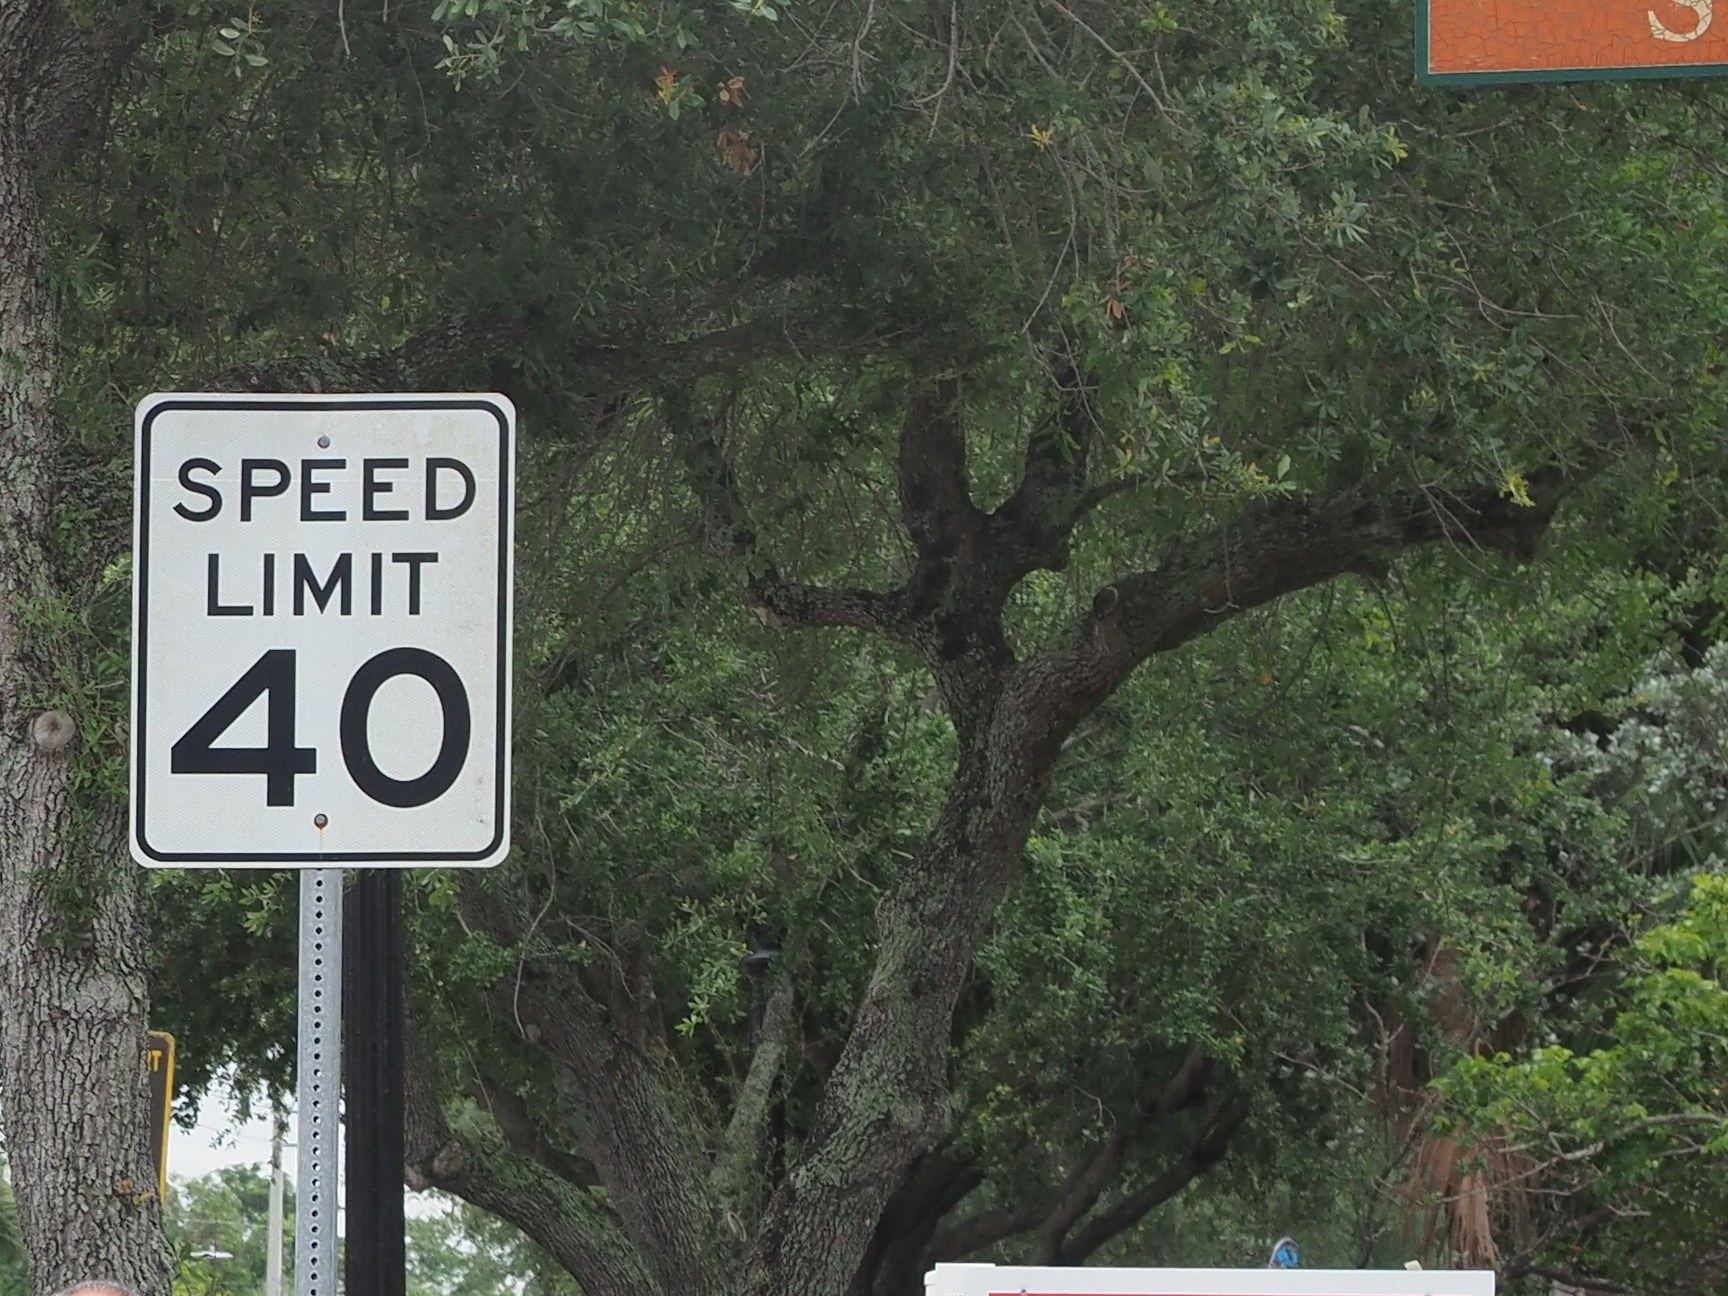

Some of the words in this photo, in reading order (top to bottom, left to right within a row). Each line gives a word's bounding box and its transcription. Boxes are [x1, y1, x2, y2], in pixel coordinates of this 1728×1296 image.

[172, 457, 477, 523] SPEED
[206, 551, 439, 617] LIMIT
[170, 646, 471, 809] 40
[149, 1050, 162, 1072] T
